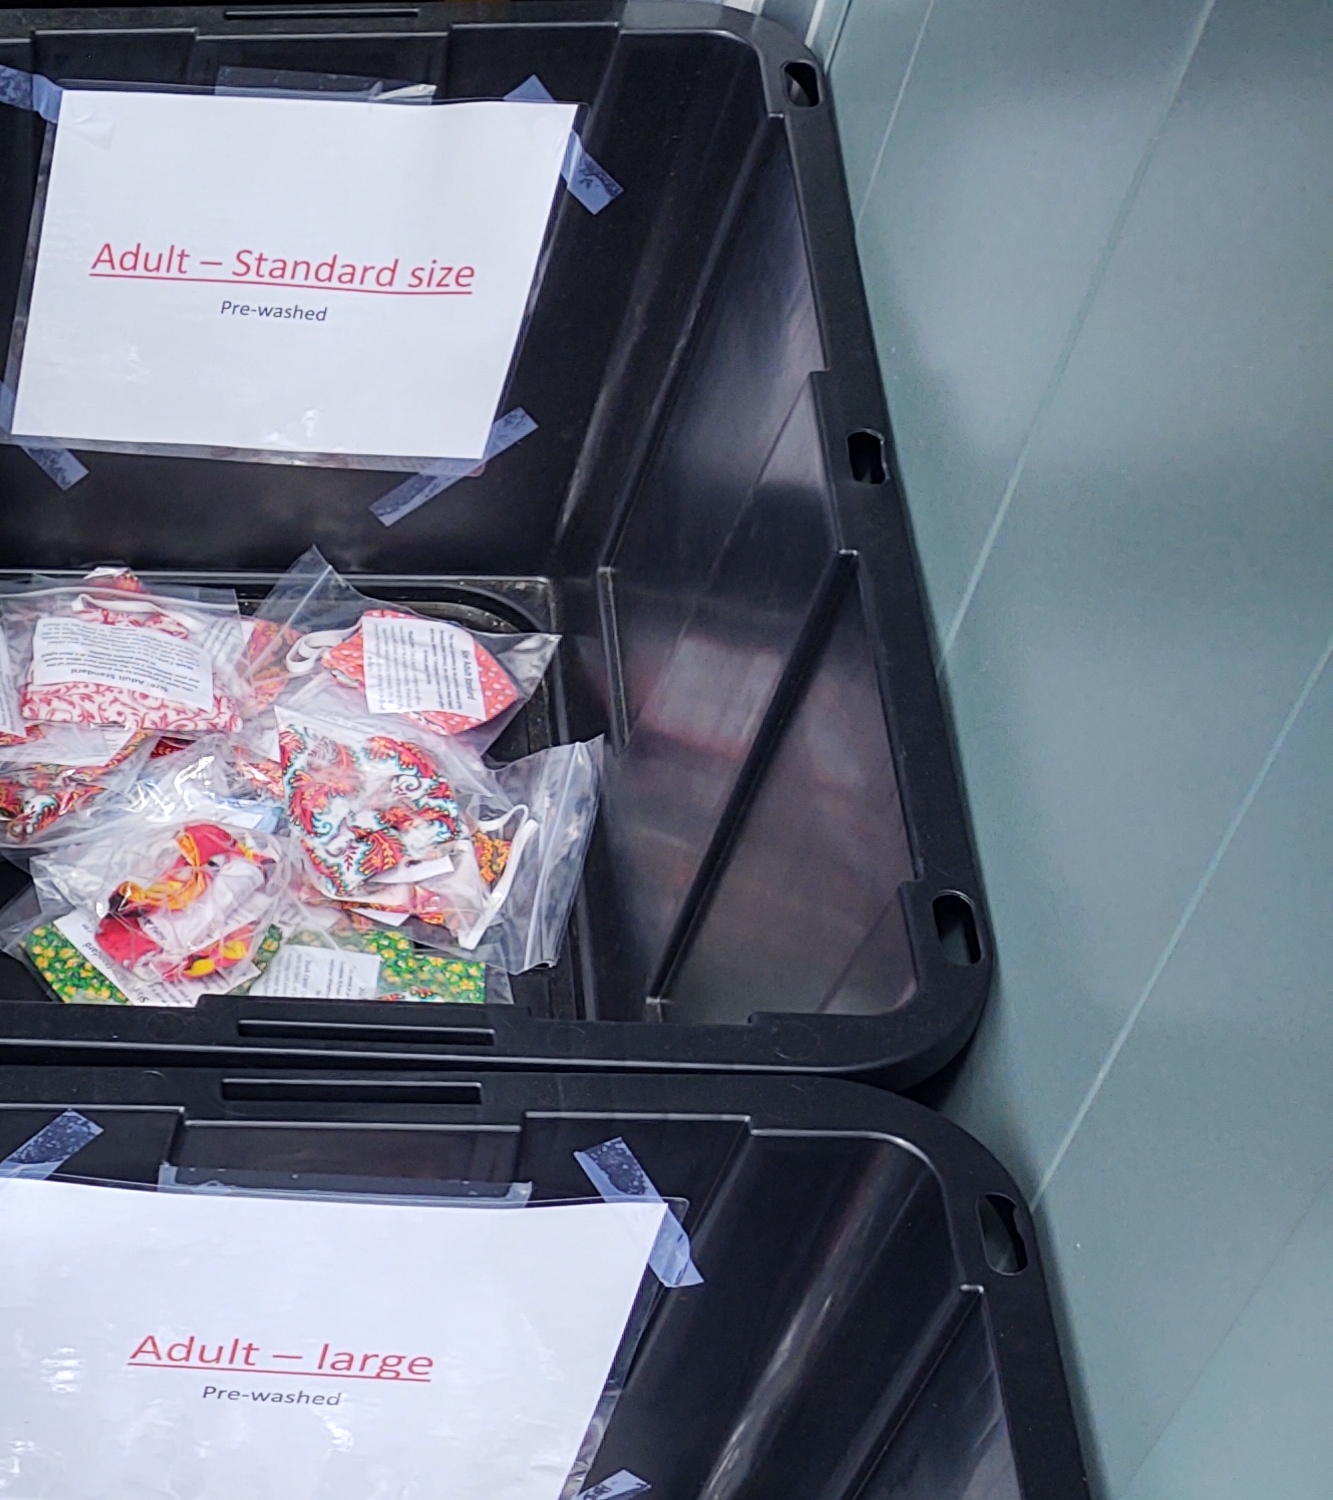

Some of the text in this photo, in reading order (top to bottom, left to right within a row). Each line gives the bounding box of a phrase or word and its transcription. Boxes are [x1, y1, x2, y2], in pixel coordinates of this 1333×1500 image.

[90, 242, 191, 275] Adult
[231, 249, 400, 288] Standard
[408, 259, 476, 289] size
[220, 300, 328, 322] Pre-washed
[70, 665, 115, 681] Standard
[118, 675, 144, 685] Adult
[129, 1335, 260, 1366] Adult
[316, 1343, 434, 1379] large
[202, 1385, 345, 1406] Pre-washed
